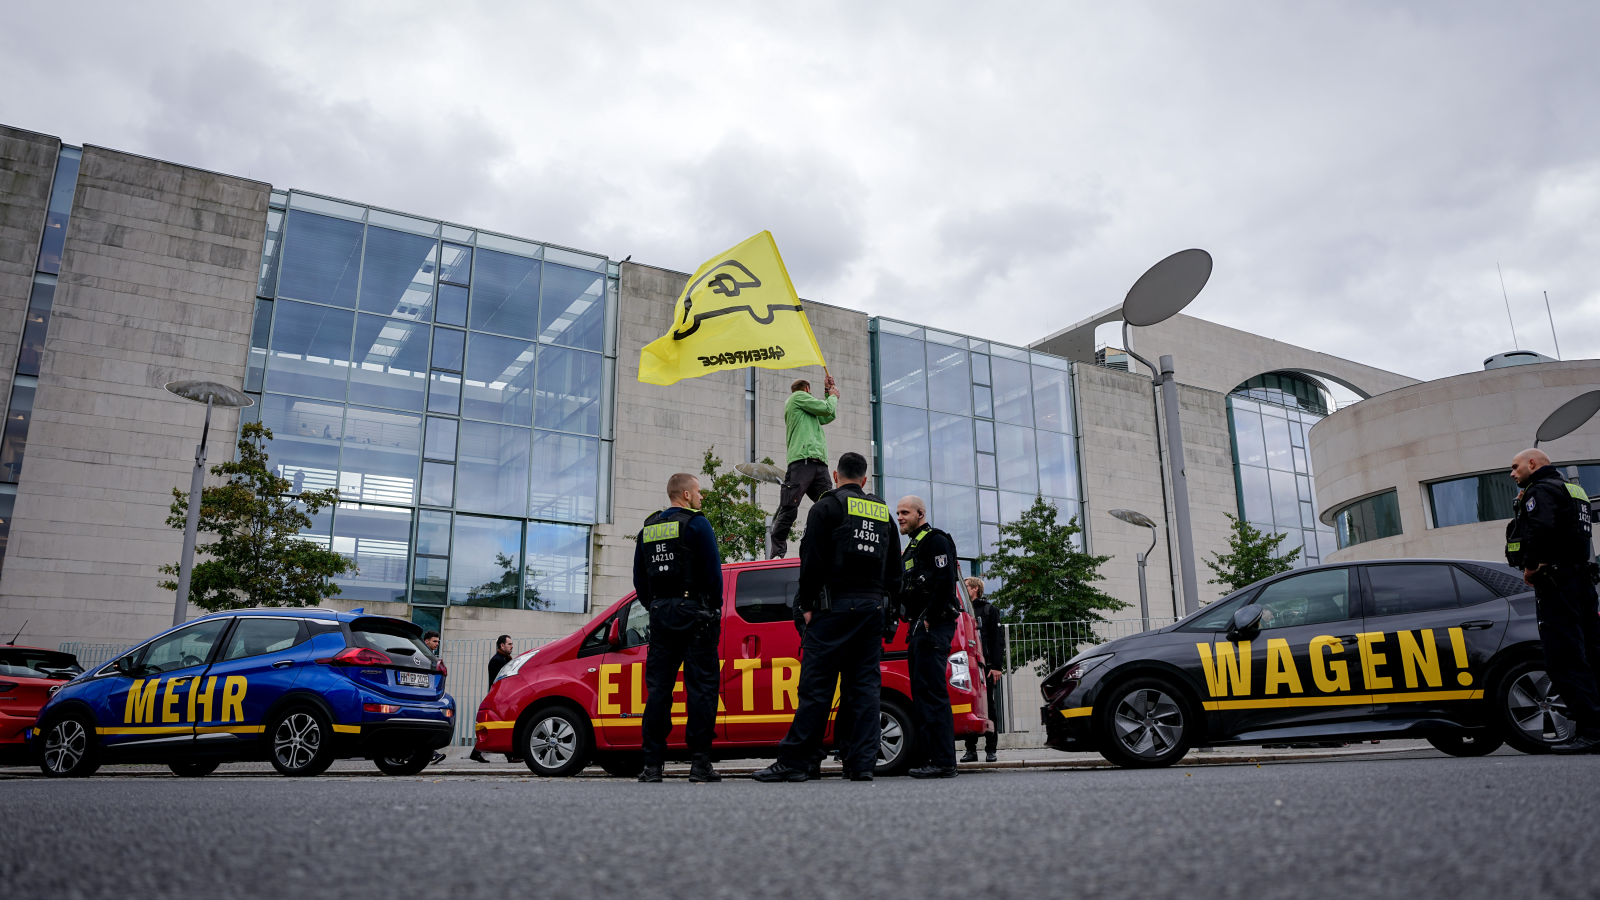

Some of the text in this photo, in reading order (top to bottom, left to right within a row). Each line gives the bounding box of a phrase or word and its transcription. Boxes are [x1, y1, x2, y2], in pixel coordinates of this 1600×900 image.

[850, 500, 888, 520] POLIZEI
[644, 522, 678, 540] POLIZEI
[862, 519, 875, 531] BE
[853, 528, 880, 543] 14301
[655, 543, 667, 553] BE
[651, 552, 675, 563] 14210
[1196, 627, 1474, 697] WAGEN!
[598, 657, 842, 714] ELTR
[124, 675, 248, 724] MEHR
